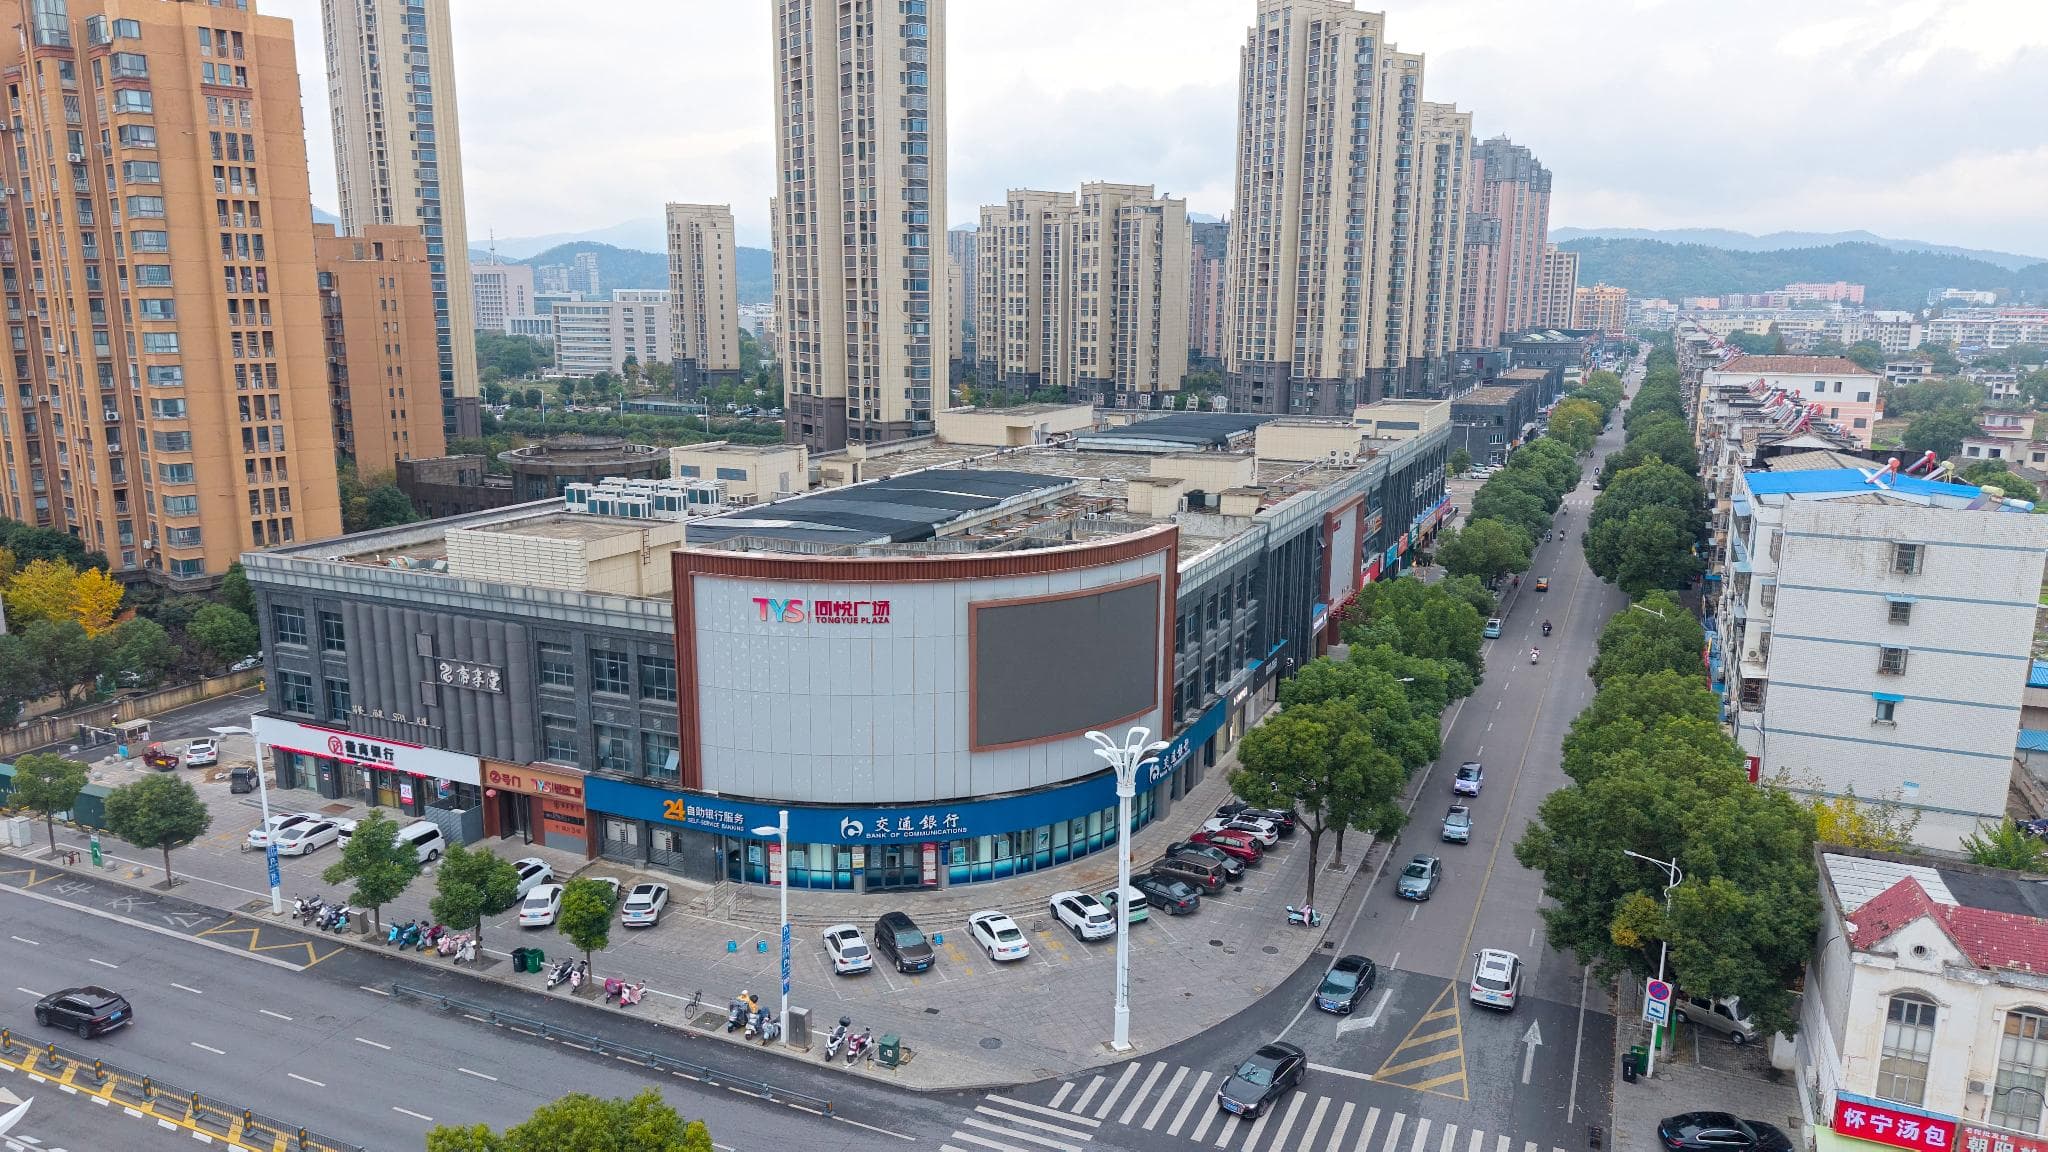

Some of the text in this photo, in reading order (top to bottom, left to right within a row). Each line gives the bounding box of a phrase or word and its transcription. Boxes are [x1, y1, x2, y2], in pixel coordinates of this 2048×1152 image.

[752, 597, 804, 623] TYS
[814, 600, 890, 616] 同悦广场
[816, 616, 890, 624] TONGYUE PLAZA
[530, 778, 552, 793] TYS
[663, 798, 686, 822] 24
[687, 805, 744, 825] 自助银行服务
[903, 827, 968, 838] COMMUNICATIONS
[1844, 1107, 1946, 1147] 怀宁汤包
